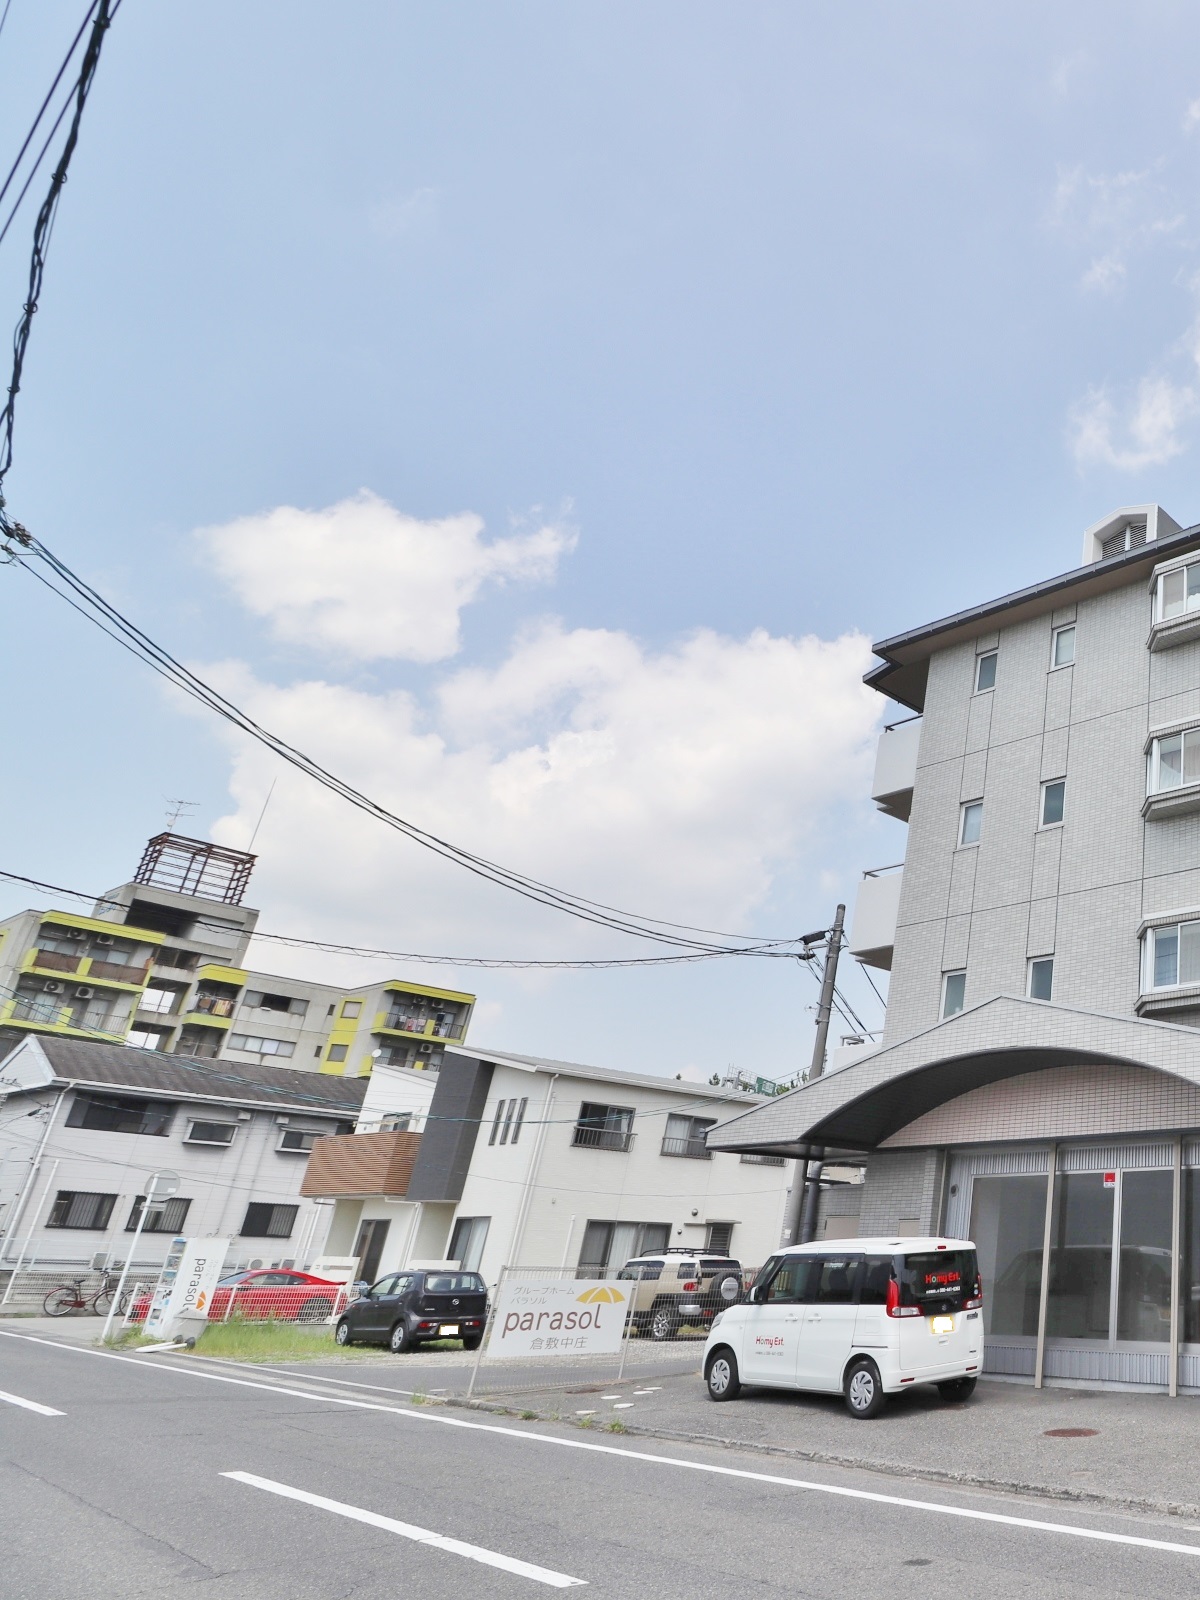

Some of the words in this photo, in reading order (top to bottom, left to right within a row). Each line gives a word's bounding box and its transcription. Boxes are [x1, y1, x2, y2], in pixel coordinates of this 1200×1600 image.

[182, 1258, 207, 1307] parasol
[513, 1286, 575, 1295] グループホーム
[510, 1296, 548, 1305] パラソル
[501, 1303, 602, 1339] parasol
[529, 1336, 589, 1350] 倉敷中庄
